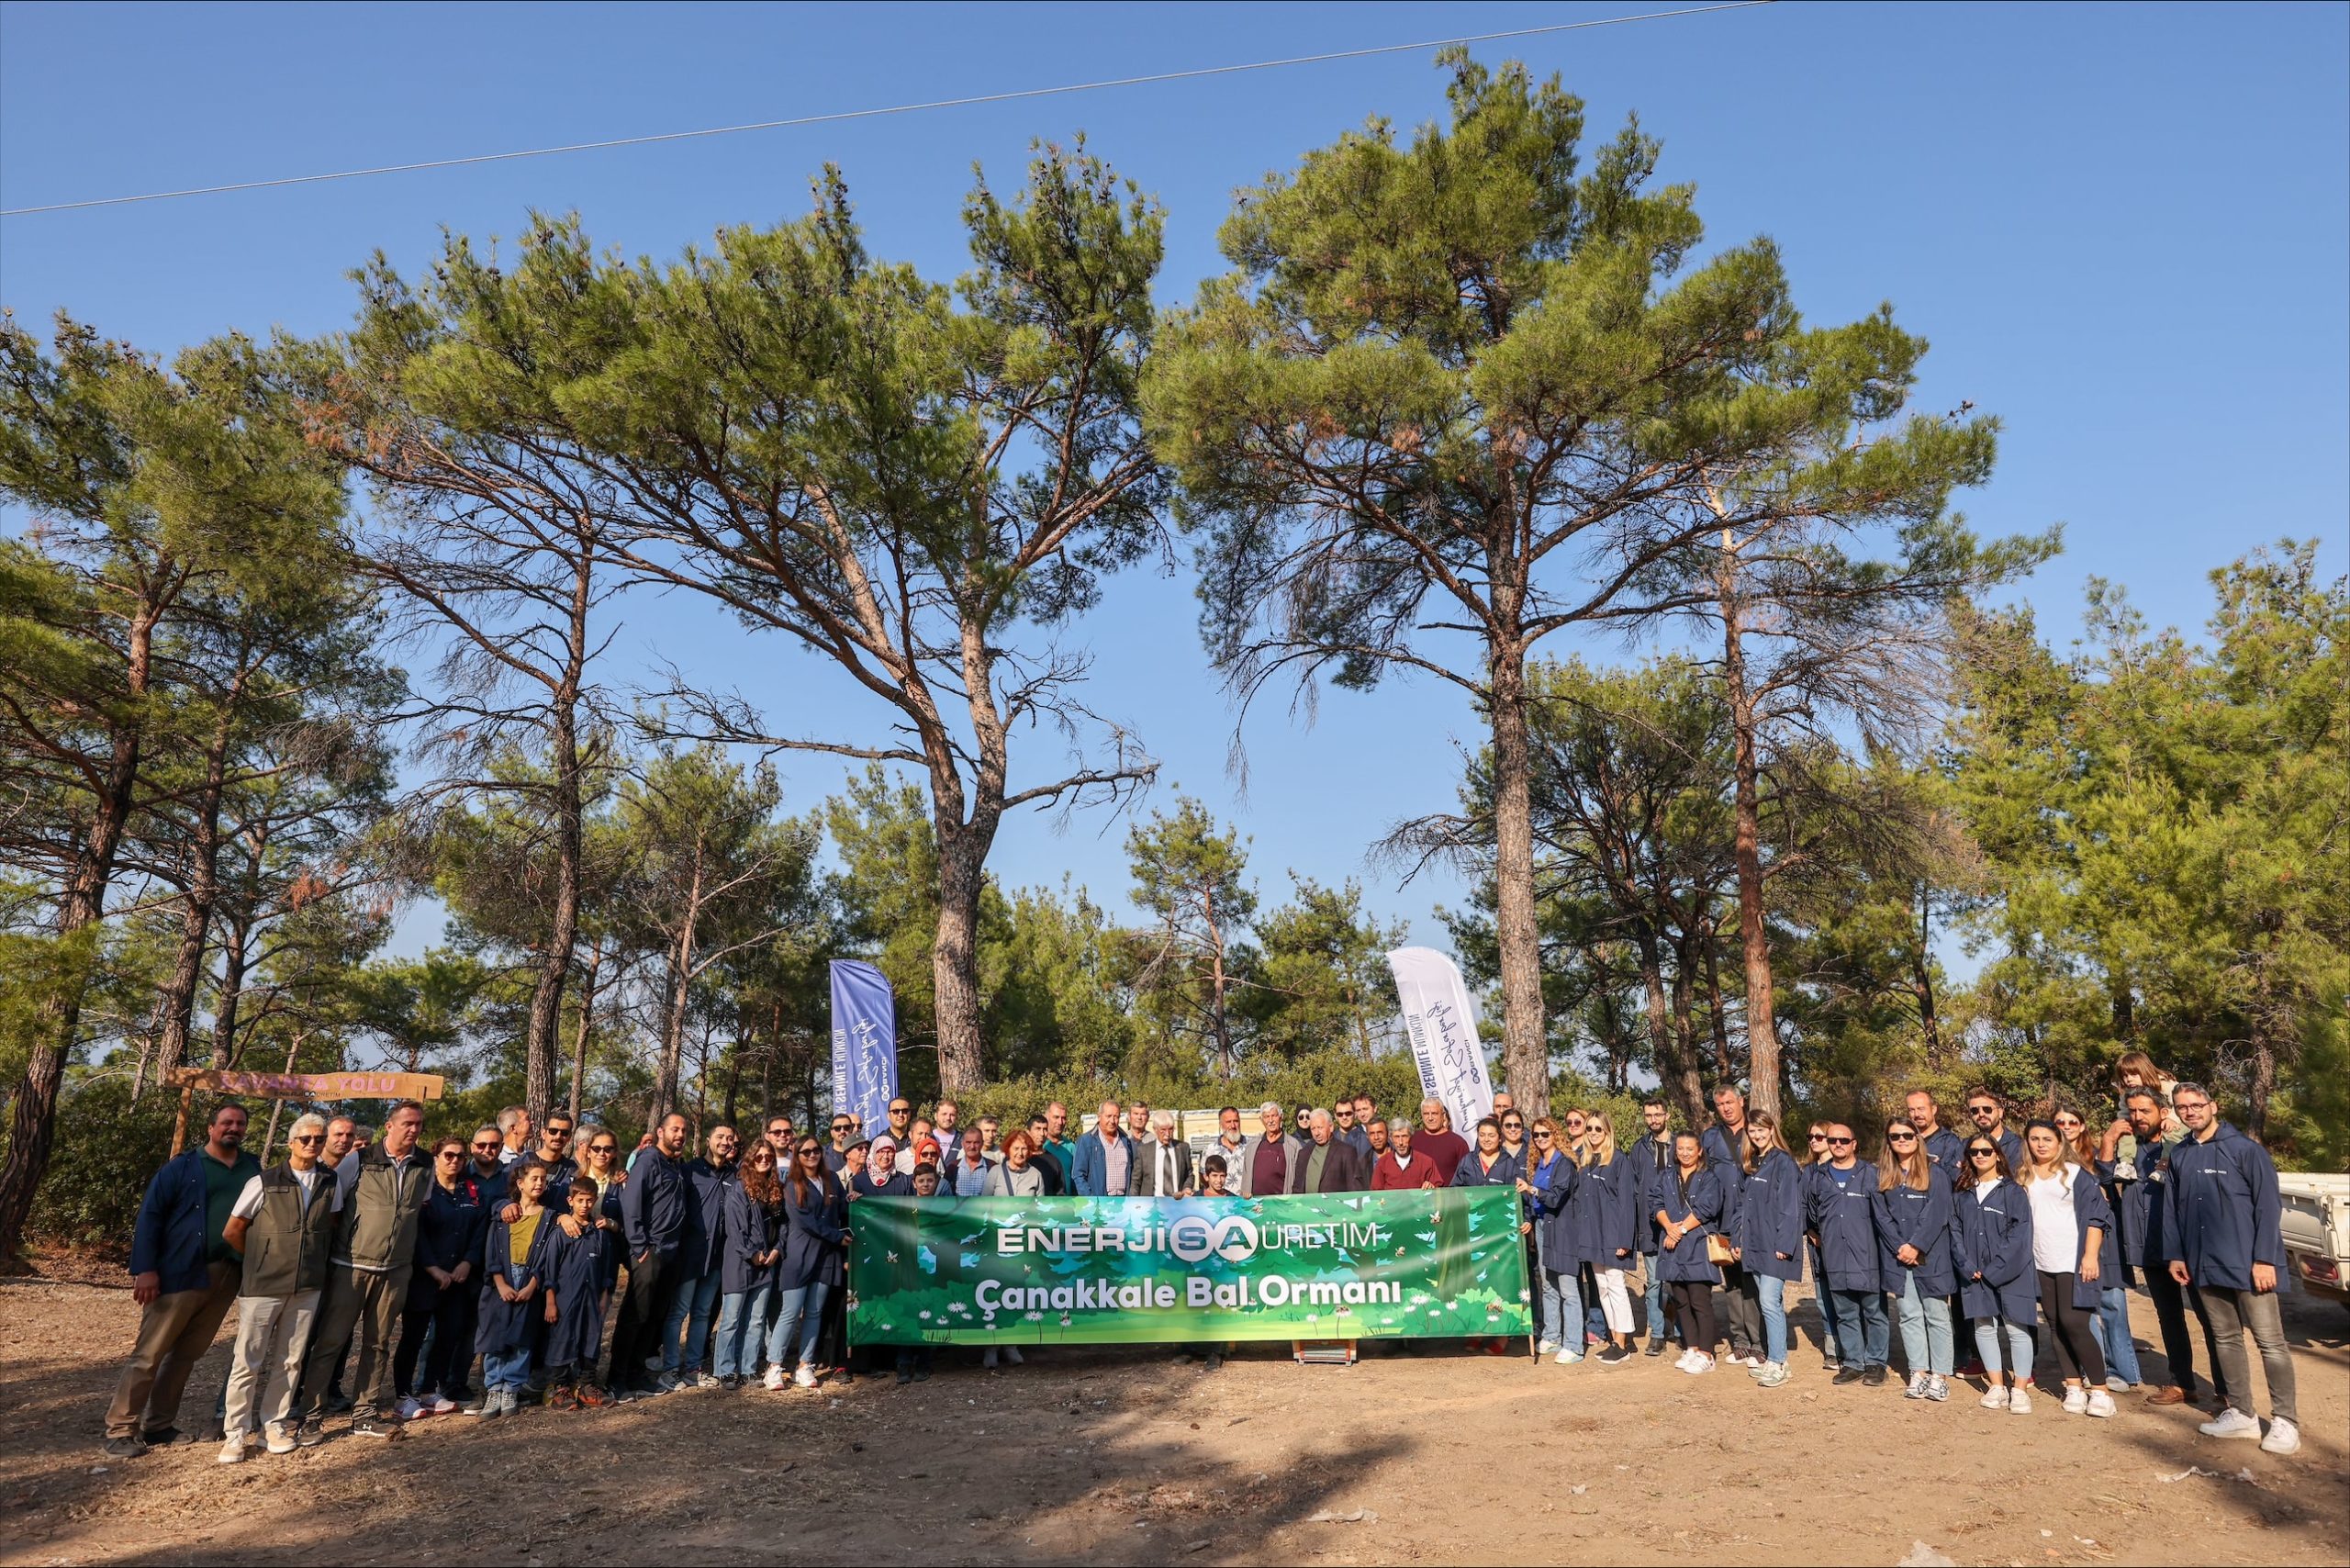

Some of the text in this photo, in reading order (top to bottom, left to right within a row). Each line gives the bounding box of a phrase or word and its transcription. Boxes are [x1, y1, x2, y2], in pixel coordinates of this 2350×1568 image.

[337, 1077, 396, 1093] YOLU
[997, 1216, 1377, 1260] ENERJİSA ÜRETİM
[975, 1274, 1401, 1321] Çanakkale Bal Ormanı
